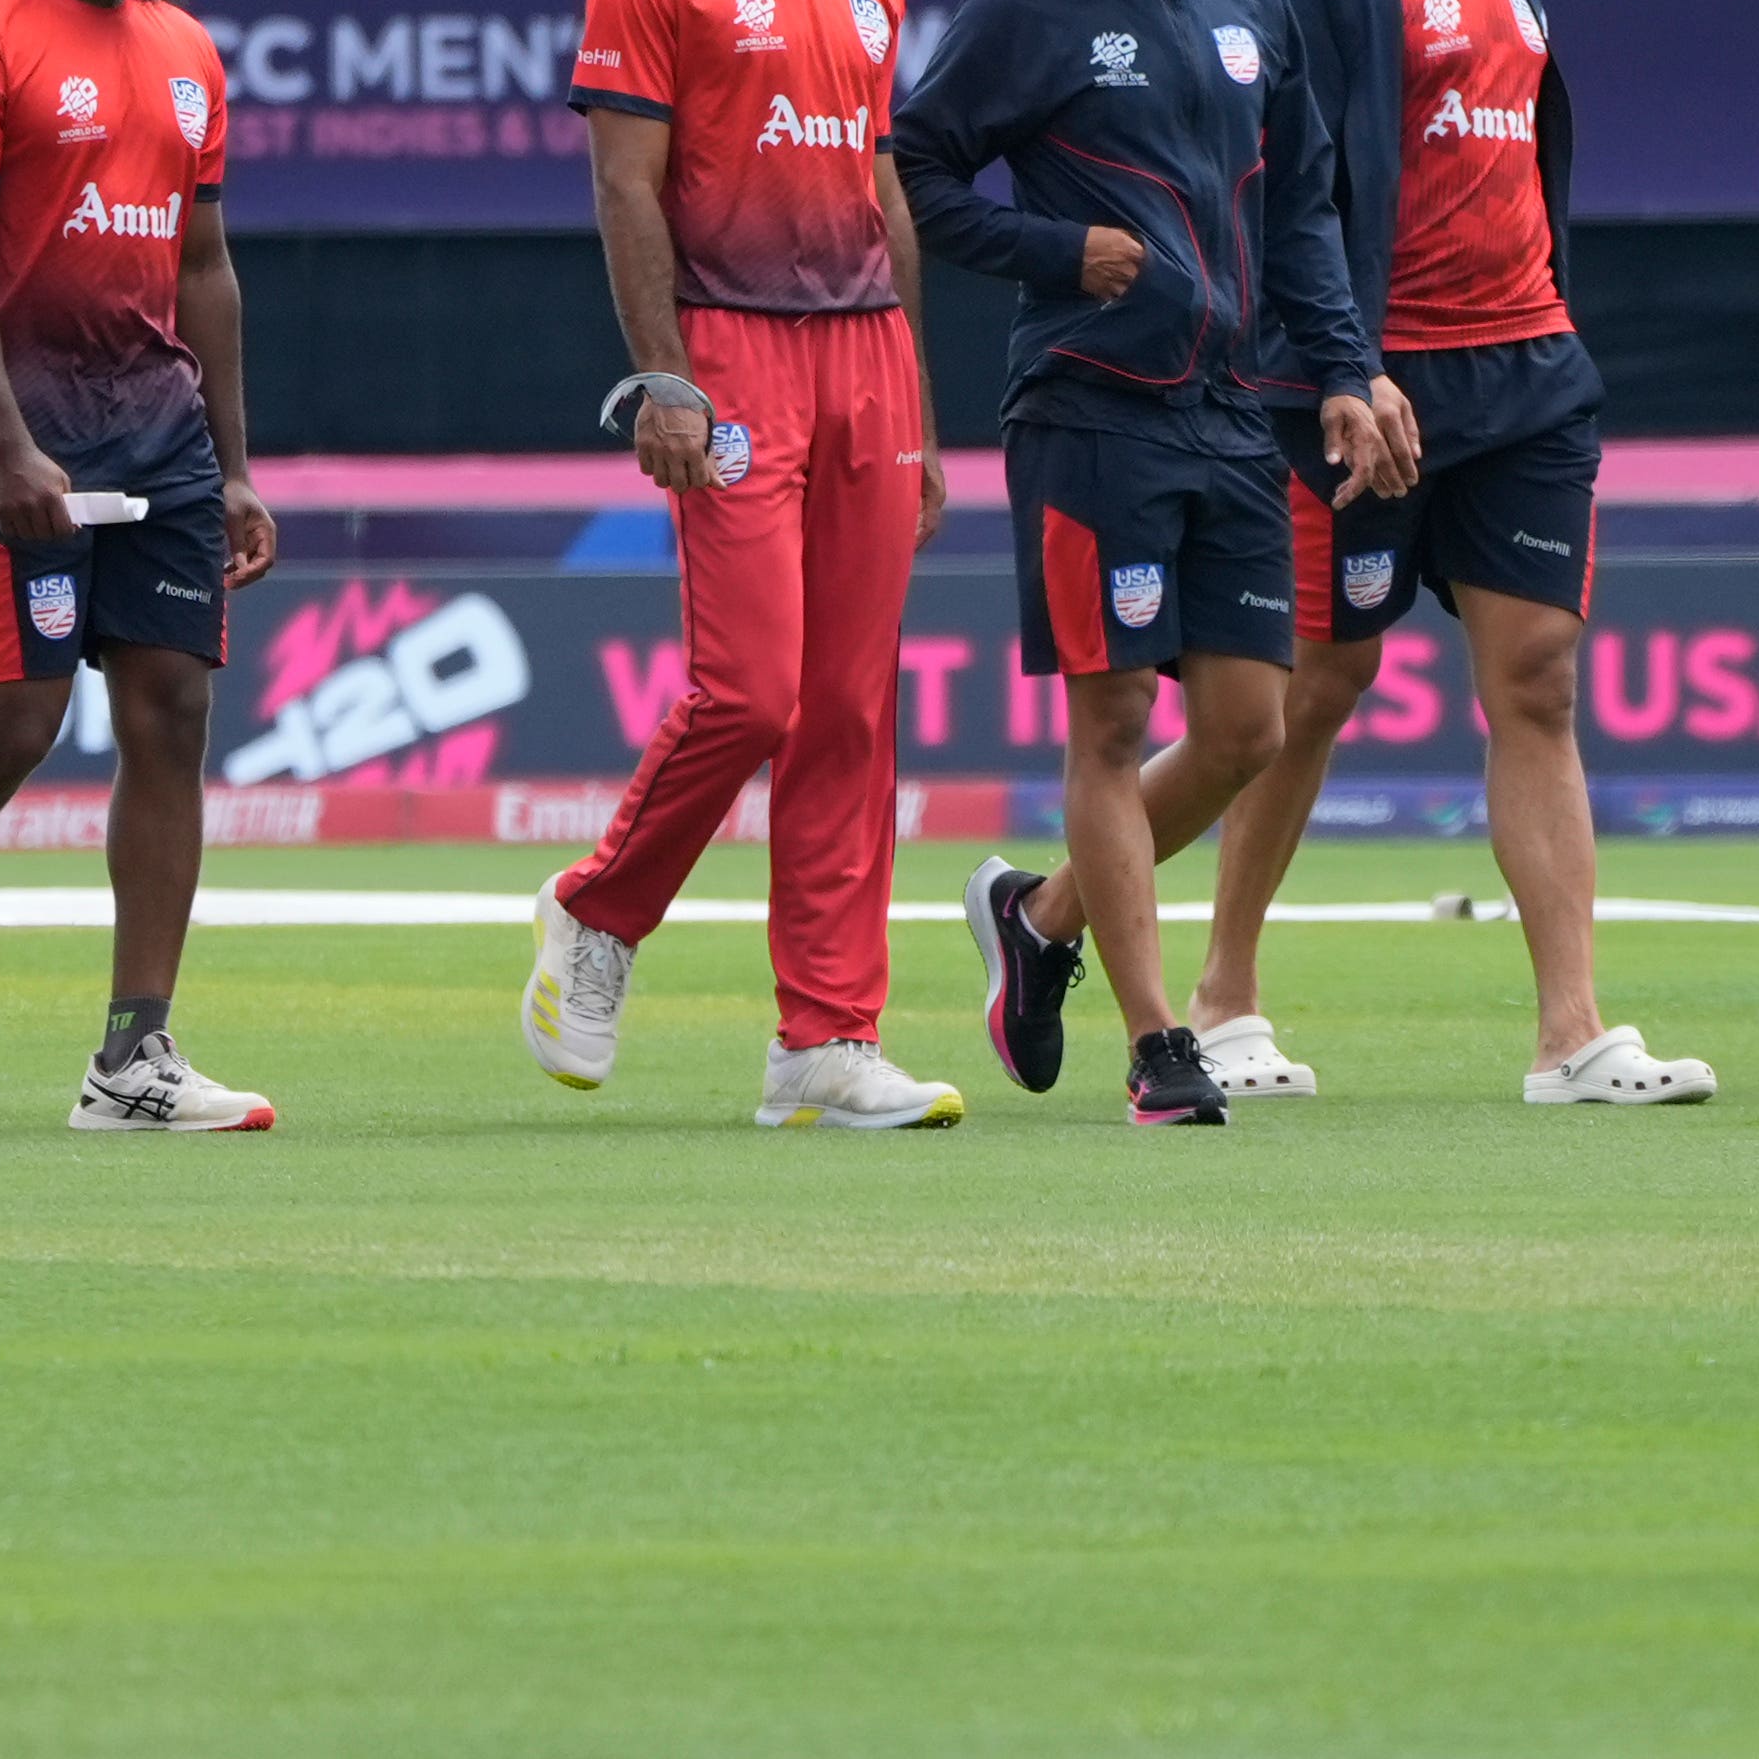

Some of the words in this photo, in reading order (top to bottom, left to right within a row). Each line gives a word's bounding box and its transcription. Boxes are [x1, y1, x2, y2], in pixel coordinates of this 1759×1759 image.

[736, 36, 767, 48] WORLD
[768, 35, 785, 45] CUP
[200, 14, 310, 104] CC
[330, 12, 582, 104] MEN'
[578, 48, 622, 69] neHill
[1095, 74, 1128, 84] WORLD
[1129, 72, 1146, 82] CUP
[58, 127, 90, 139] WORLD
[91, 125, 106, 136] CUP
[63, 181, 182, 241] Amul
[711, 423, 746, 444] SA
[1346, 553, 1392, 574] USA
[29, 576, 74, 598] USA
[1114, 566, 1161, 588] USA
